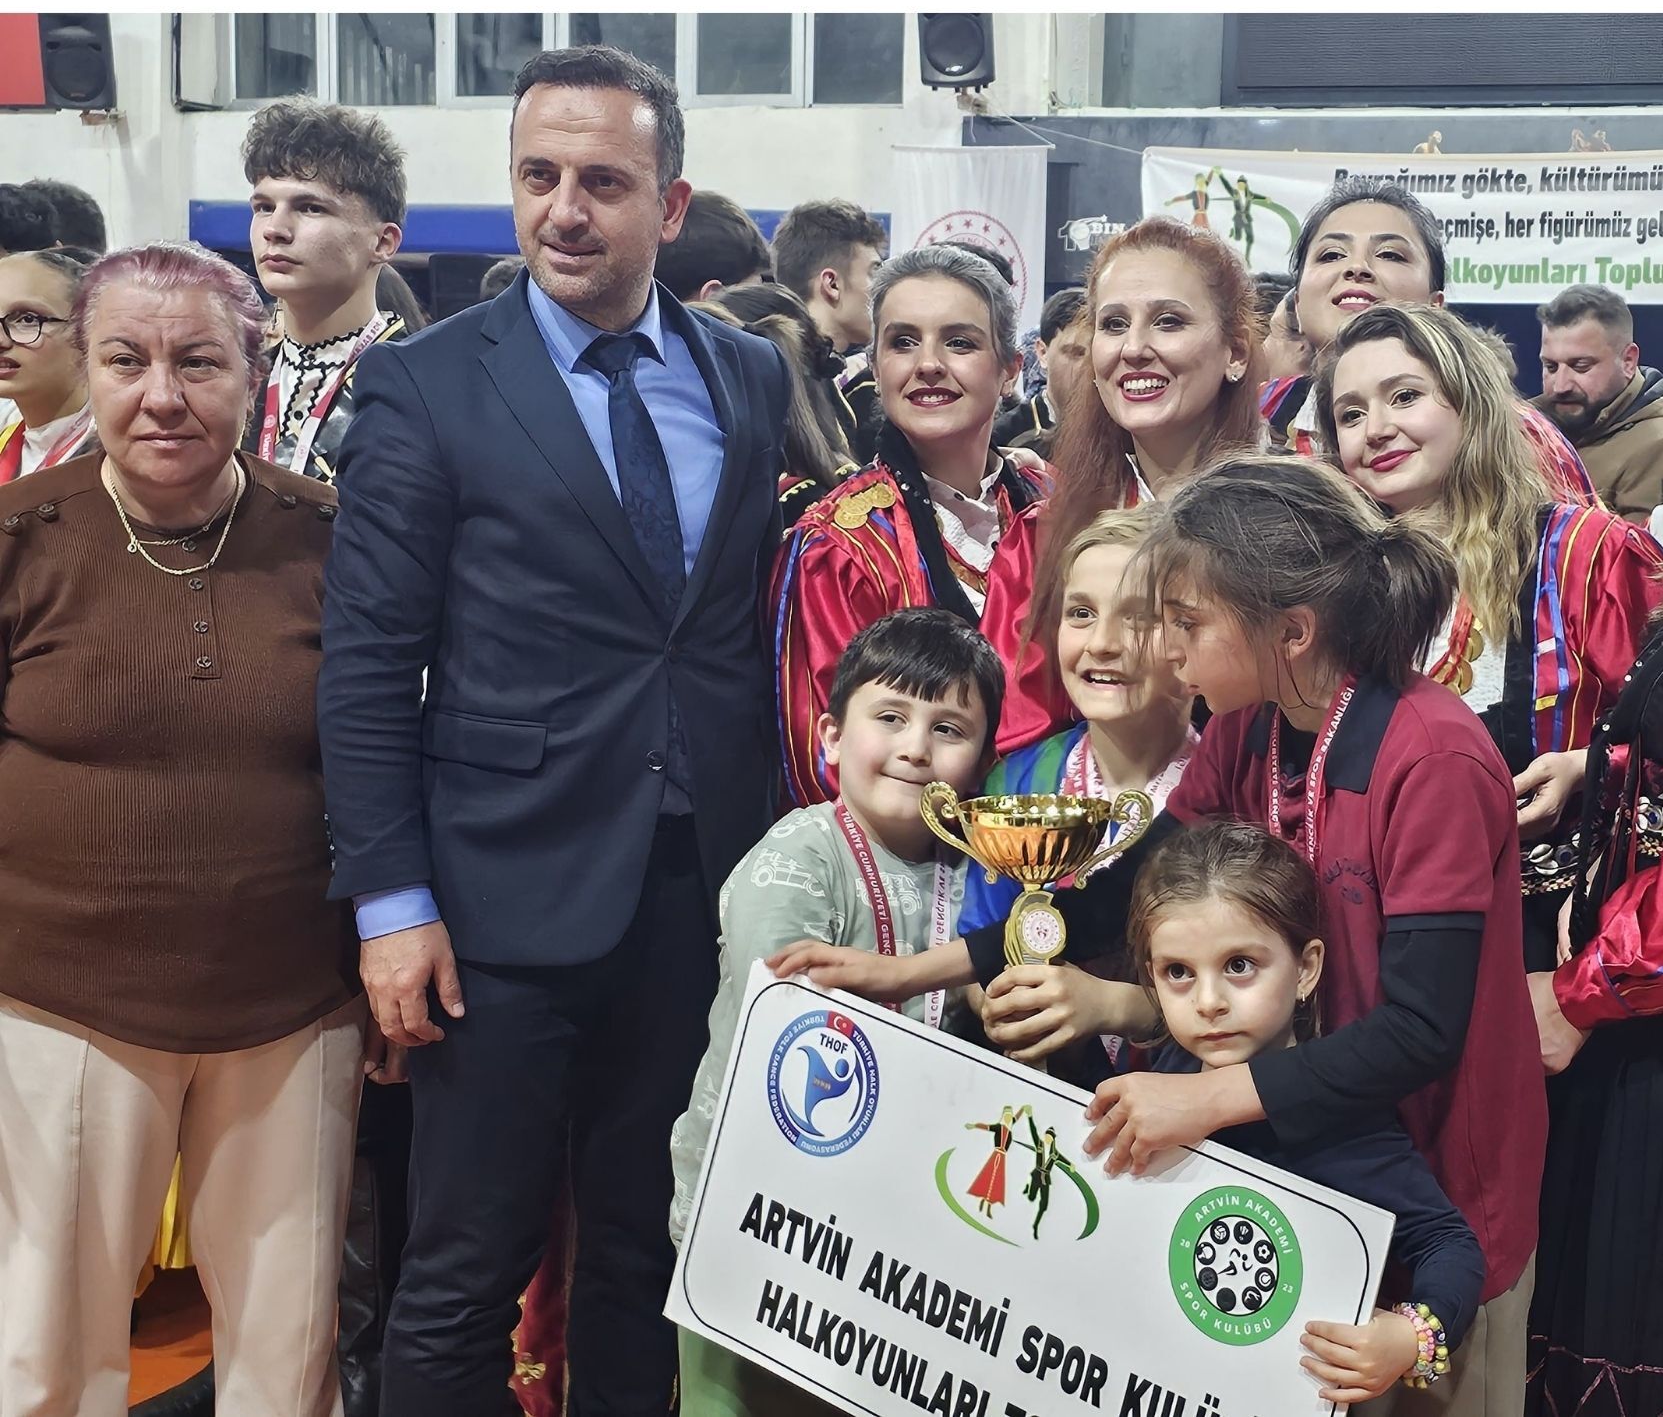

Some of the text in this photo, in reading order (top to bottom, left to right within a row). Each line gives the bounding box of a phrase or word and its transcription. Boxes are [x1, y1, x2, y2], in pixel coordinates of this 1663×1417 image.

[1461, 166, 1533, 199] gökte,
[1437, 212, 1500, 245] eçmişe,
[1505, 211, 1535, 238] her
[1540, 210, 1632, 245] figürümüz
[1452, 257, 1588, 290] lkoyunları
[1310, 757, 1323, 788] SPOR
[1321, 686, 1356, 754] BAKANLIĞI
[841, 811, 887, 921] TÜRKİYE CUMHURİYETİ
[820, 1033, 848, 1054] THOF
[1194, 1194, 1294, 1254] ARTVİN AKADEMİ
[739, 1192, 1109, 1409] ARTVİN AKADEMİ SPOR
[1180, 1282, 1272, 1335] SPOR KULÜBÜ
[1282, 1283, 1294, 1293] 23
[756, 1278, 991, 1417] HALKOYUNLARI
